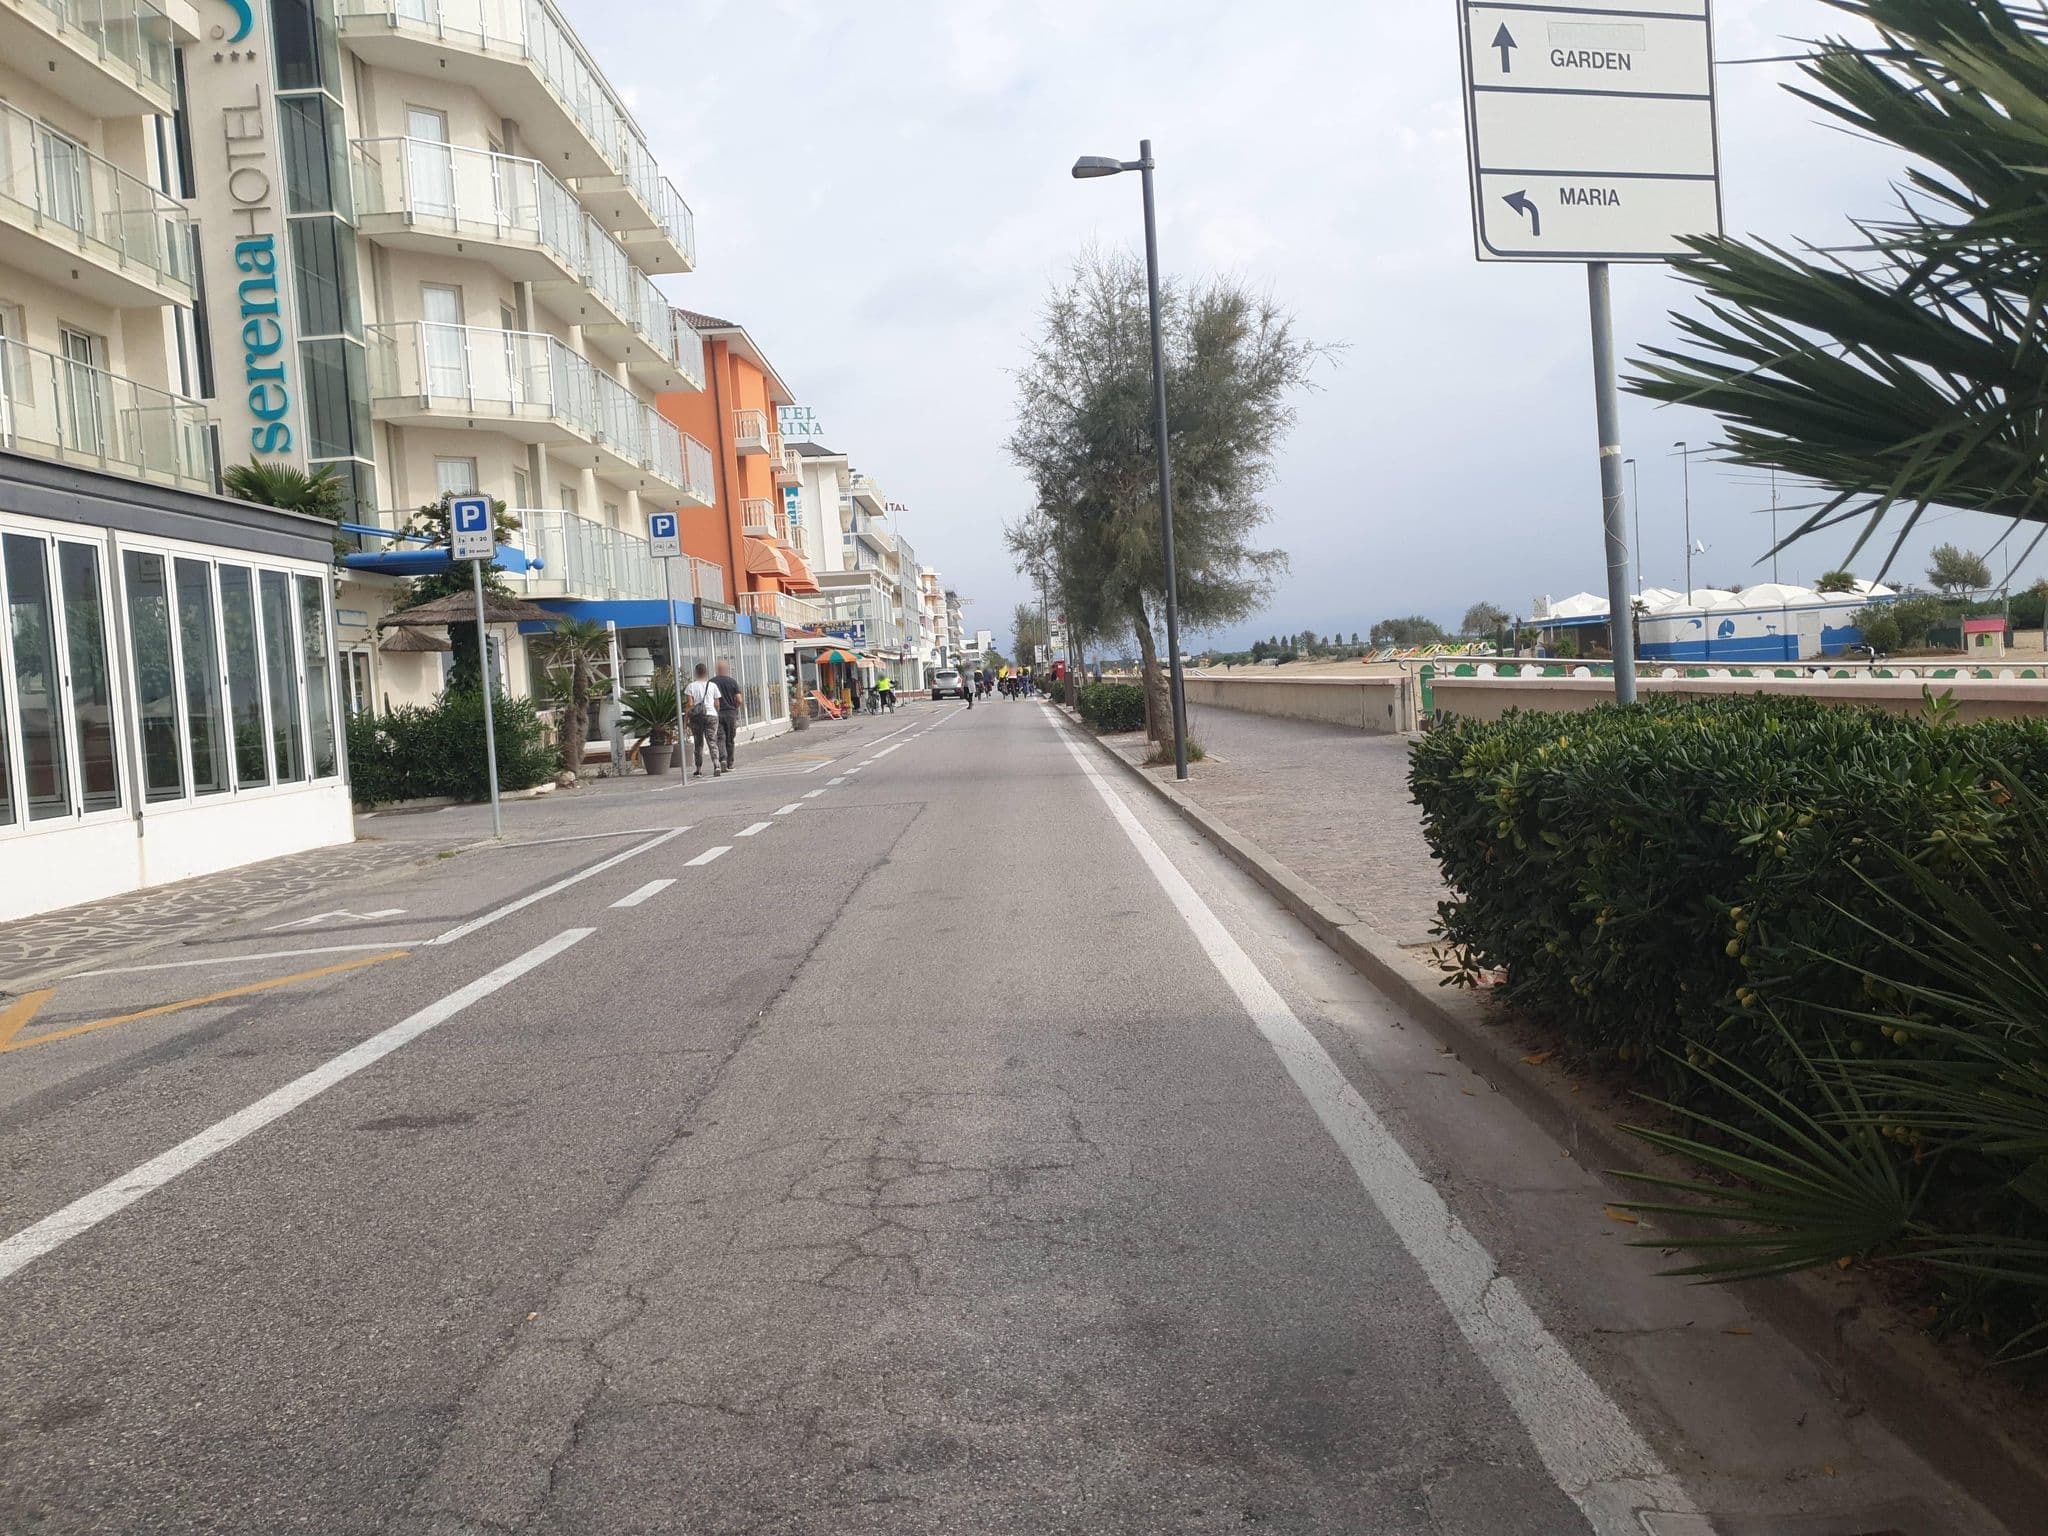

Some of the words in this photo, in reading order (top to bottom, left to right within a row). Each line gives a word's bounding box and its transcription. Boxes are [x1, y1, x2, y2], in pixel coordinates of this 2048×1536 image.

[1550, 49, 1632, 71] GARDEN
[222, 84, 273, 239] HOTEL
[1560, 187, 1621, 207] MARIA
[234, 233, 292, 454] serena
[461, 505, 480, 529] P
[656, 518, 670, 535] P
